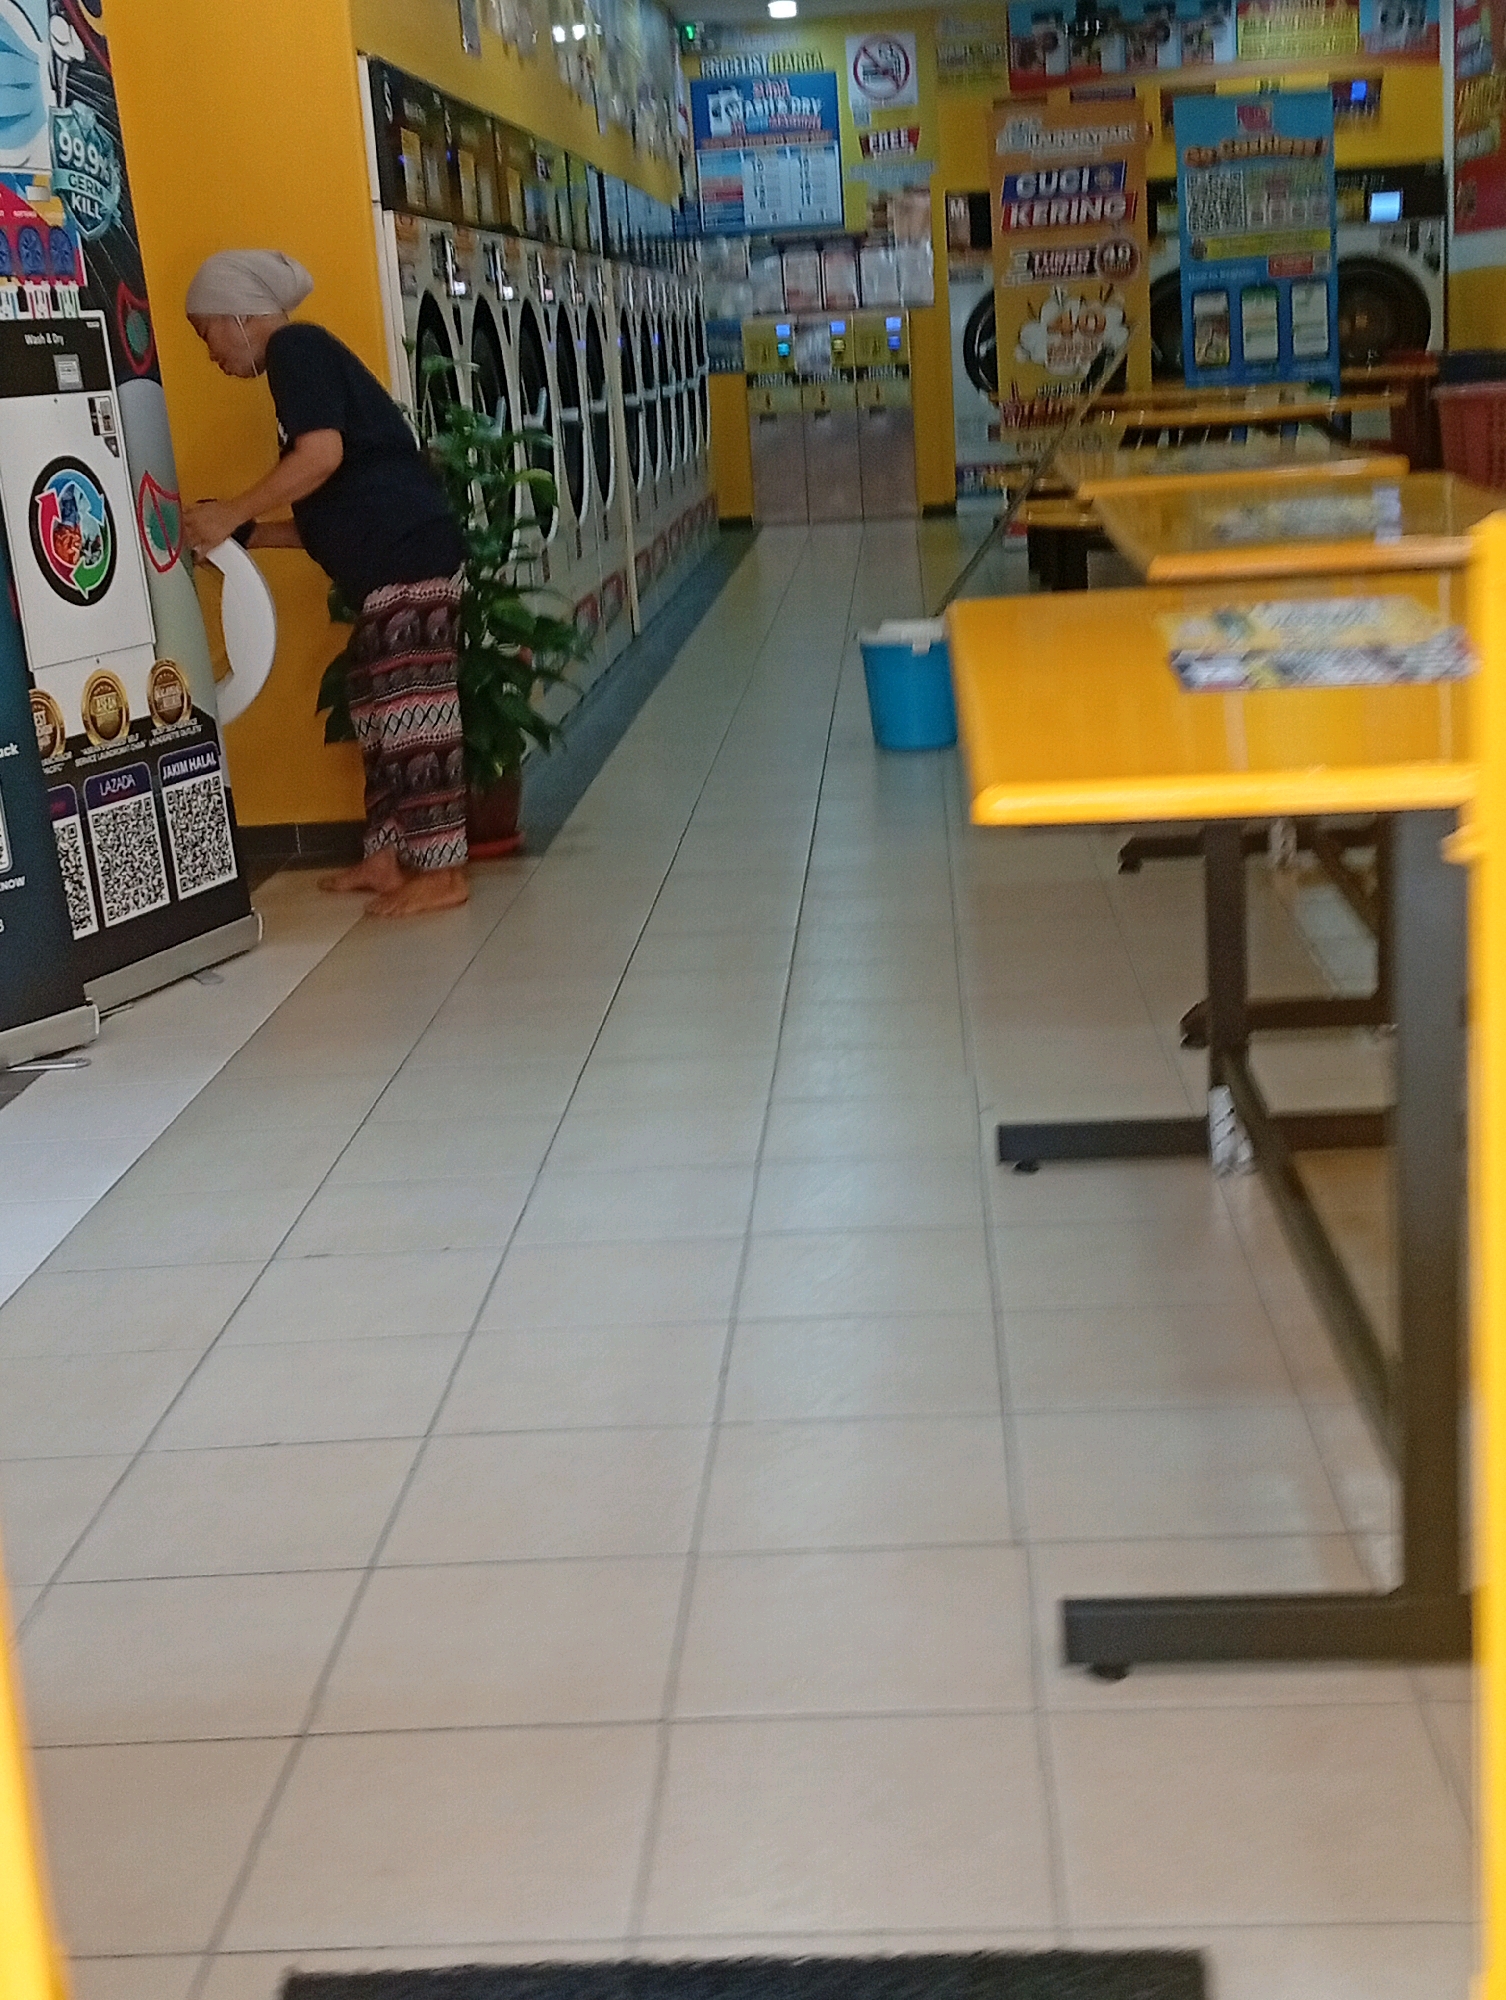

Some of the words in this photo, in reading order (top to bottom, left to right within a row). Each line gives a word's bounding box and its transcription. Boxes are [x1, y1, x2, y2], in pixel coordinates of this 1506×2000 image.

[58, 131, 112, 184] 99.9%
[68, 173, 103, 196] GERM
[1016, 167, 1090, 199] CUCI
[71, 192, 102, 220] KILL
[1010, 193, 1126, 229] KERING
[162, 757, 188, 780] JAKIM
[188, 751, 217, 770] HALAL
[100, 773, 136, 796] LAZADA
